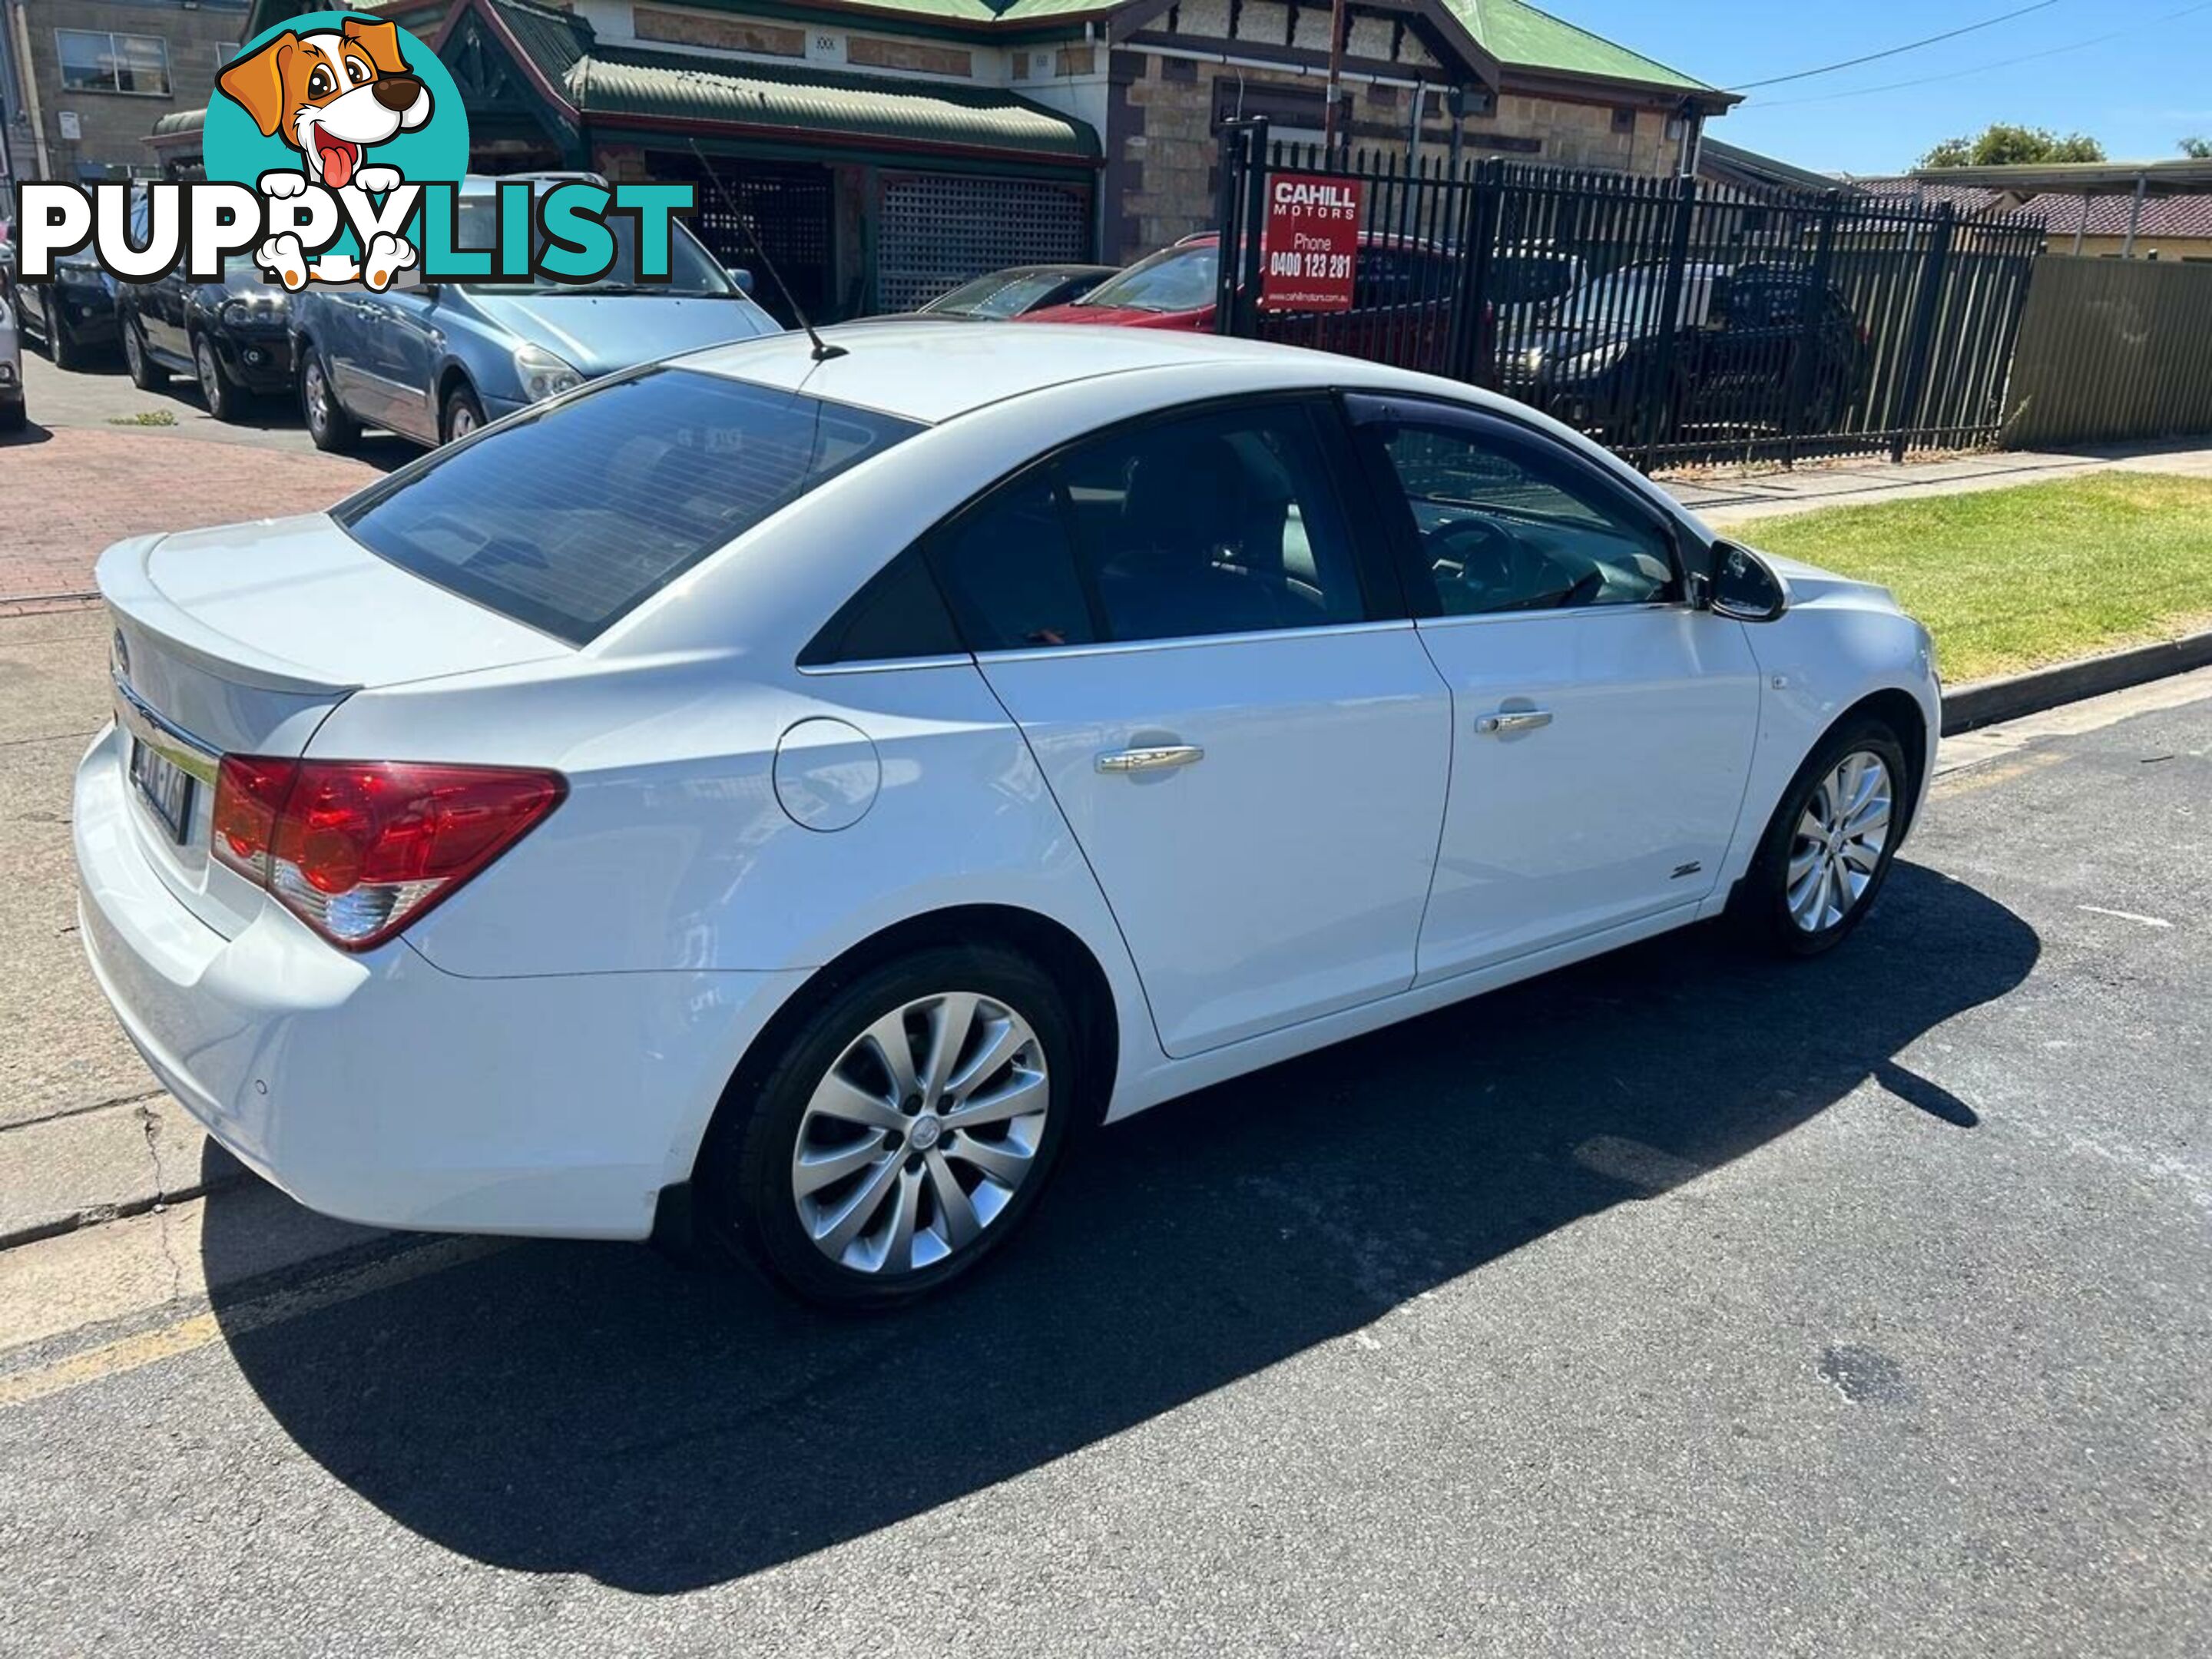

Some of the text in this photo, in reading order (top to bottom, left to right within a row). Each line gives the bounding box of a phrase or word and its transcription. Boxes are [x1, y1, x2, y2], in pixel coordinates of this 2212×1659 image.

[1275, 183, 1356, 207] CAHILL
[1273, 204, 1354, 220] MOTORS
[1294, 233, 1331, 251] Phone
[1270, 252, 1350, 279] 0400 123 281
